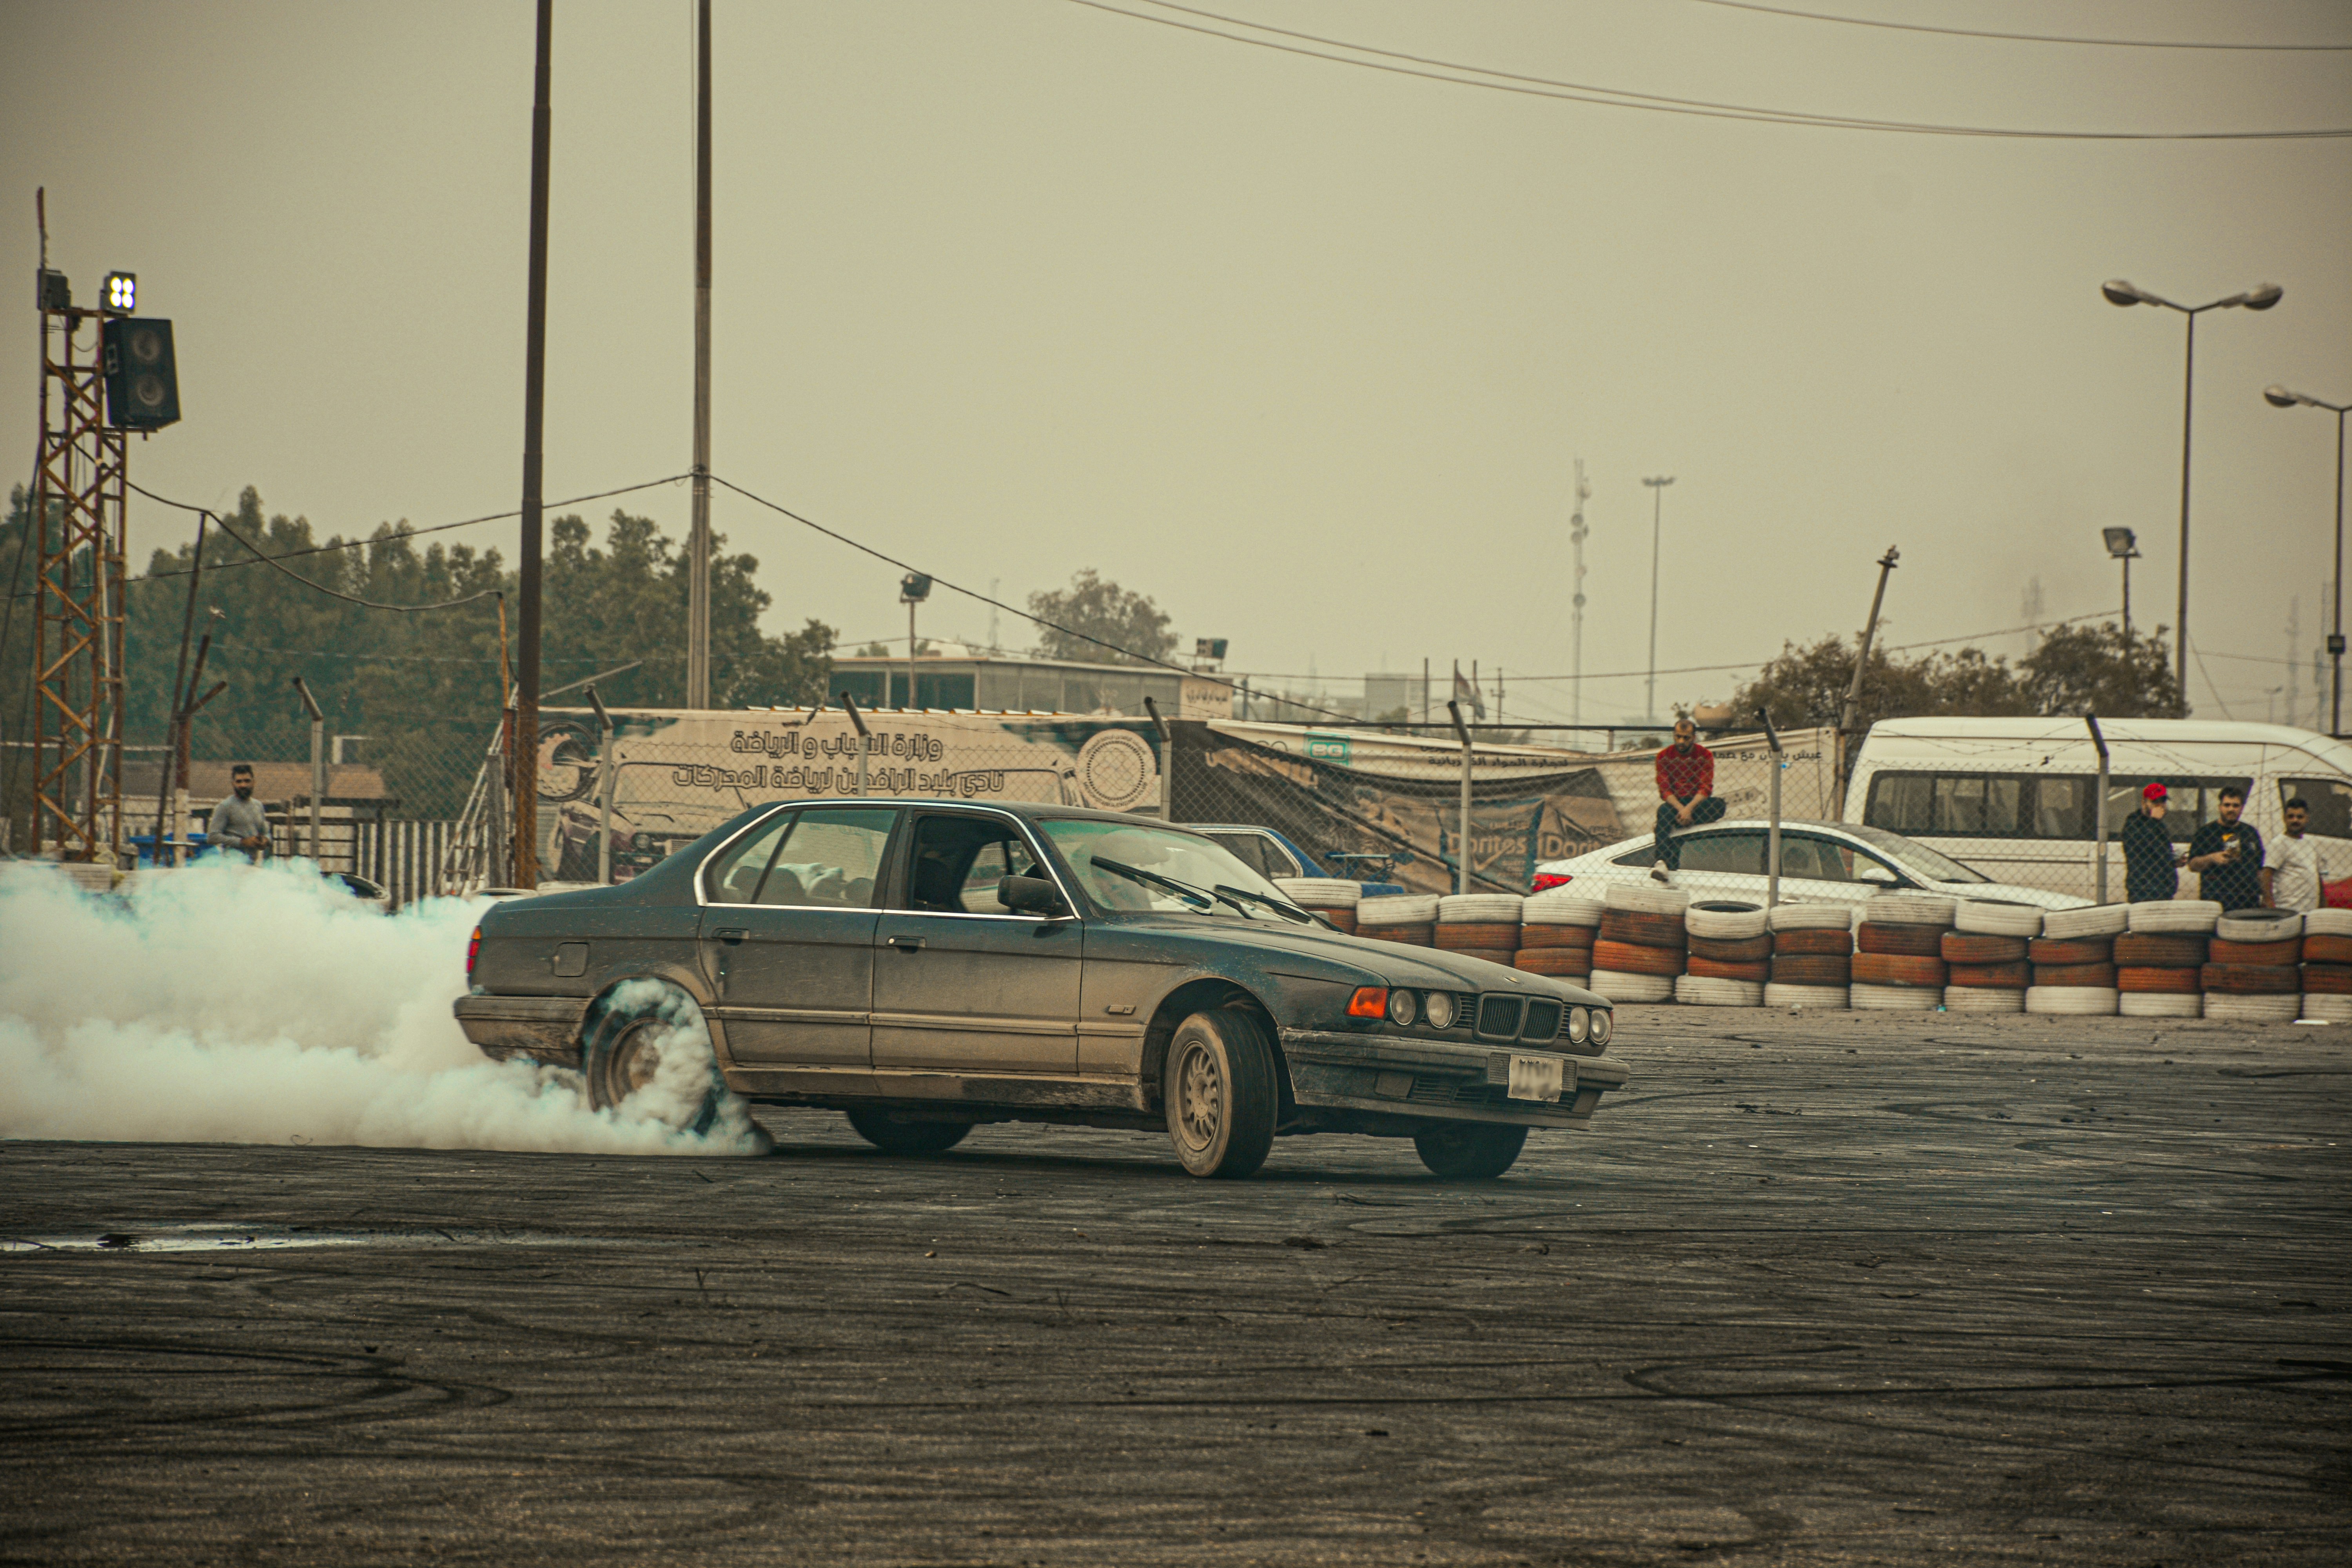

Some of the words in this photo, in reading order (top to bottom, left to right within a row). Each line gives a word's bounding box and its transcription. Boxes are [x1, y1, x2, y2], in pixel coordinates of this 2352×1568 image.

[731, 730, 799, 758] الرياضة
[802, 737, 818, 759] و
[892, 733, 943, 761] وزارة
[1741, 751, 1755, 761] مع
[673, 764, 767, 792] المحركات
[771, 766, 833, 794] لرياضة
[960, 769, 1004, 799] نادي
